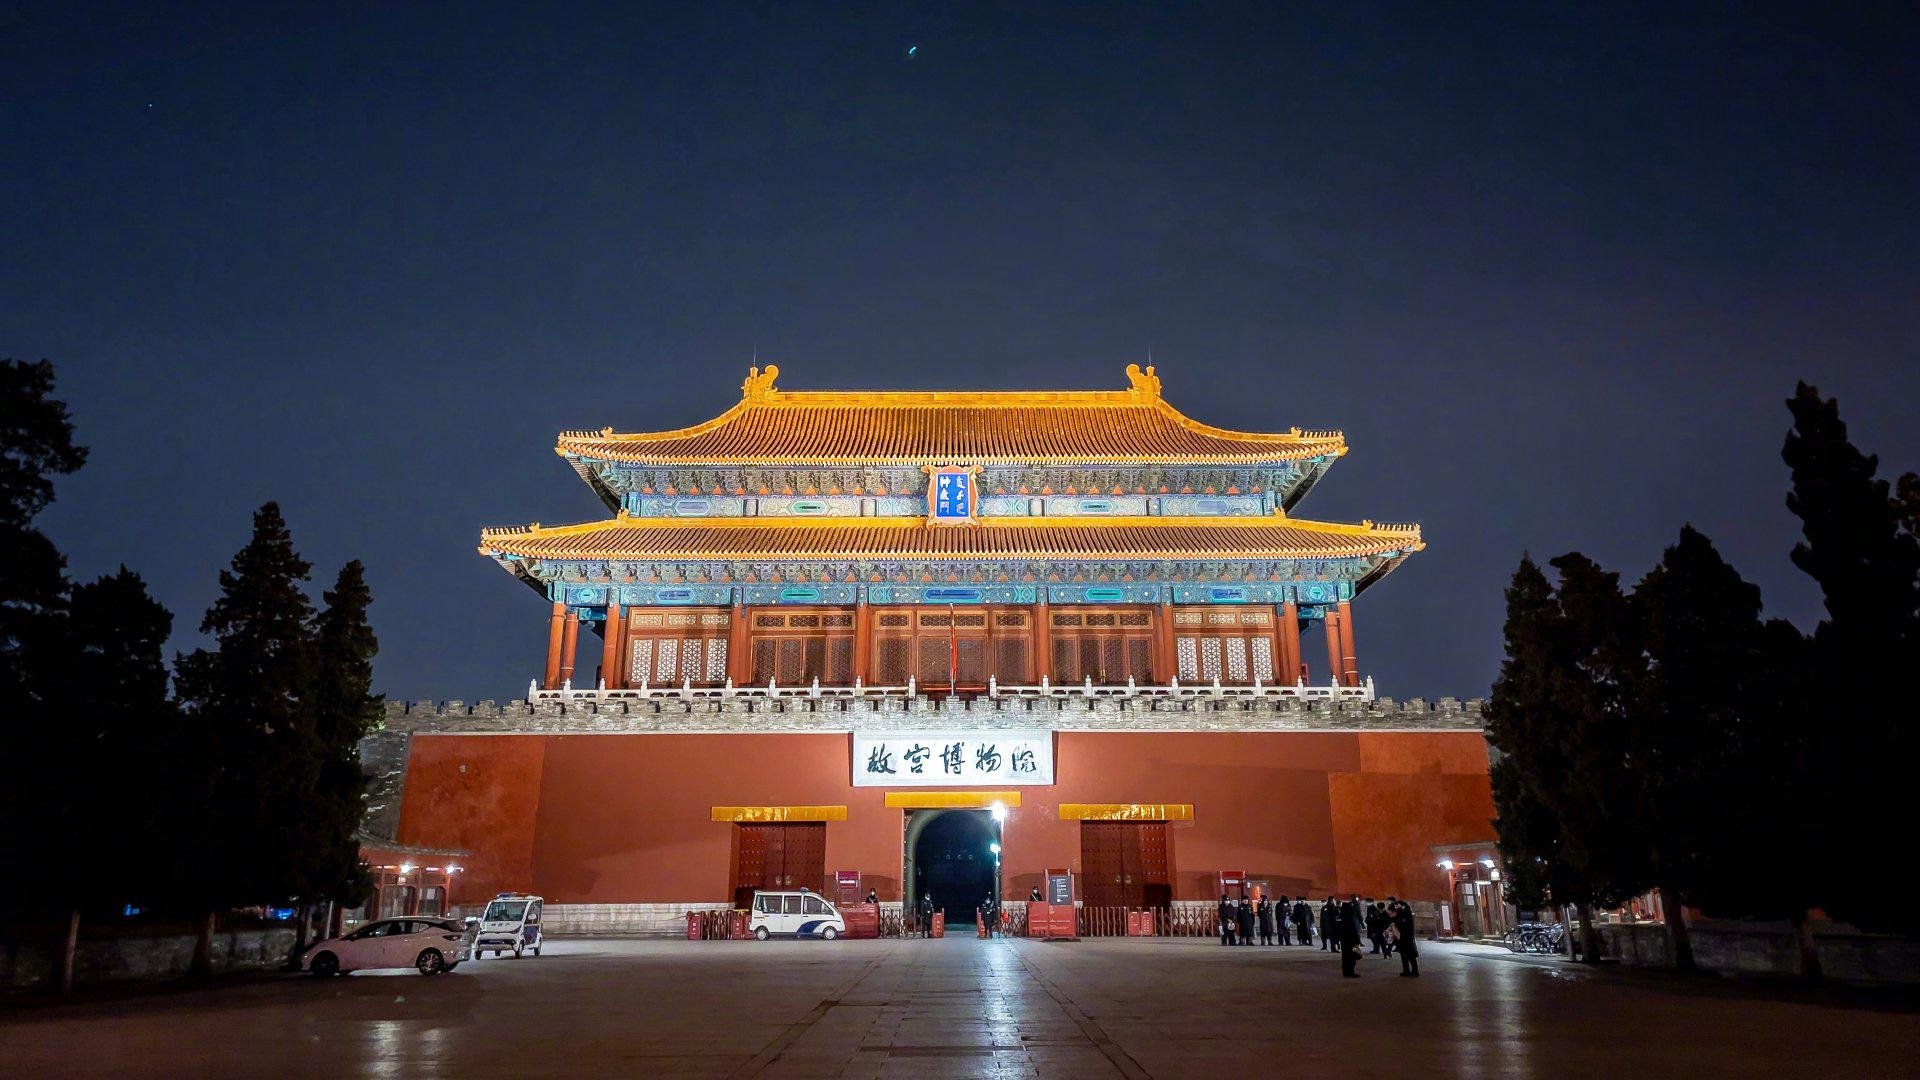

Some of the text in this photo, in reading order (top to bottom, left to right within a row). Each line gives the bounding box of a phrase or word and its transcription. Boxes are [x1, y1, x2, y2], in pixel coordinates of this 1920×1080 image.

[866, 742, 1037, 775] 故宫博物院
